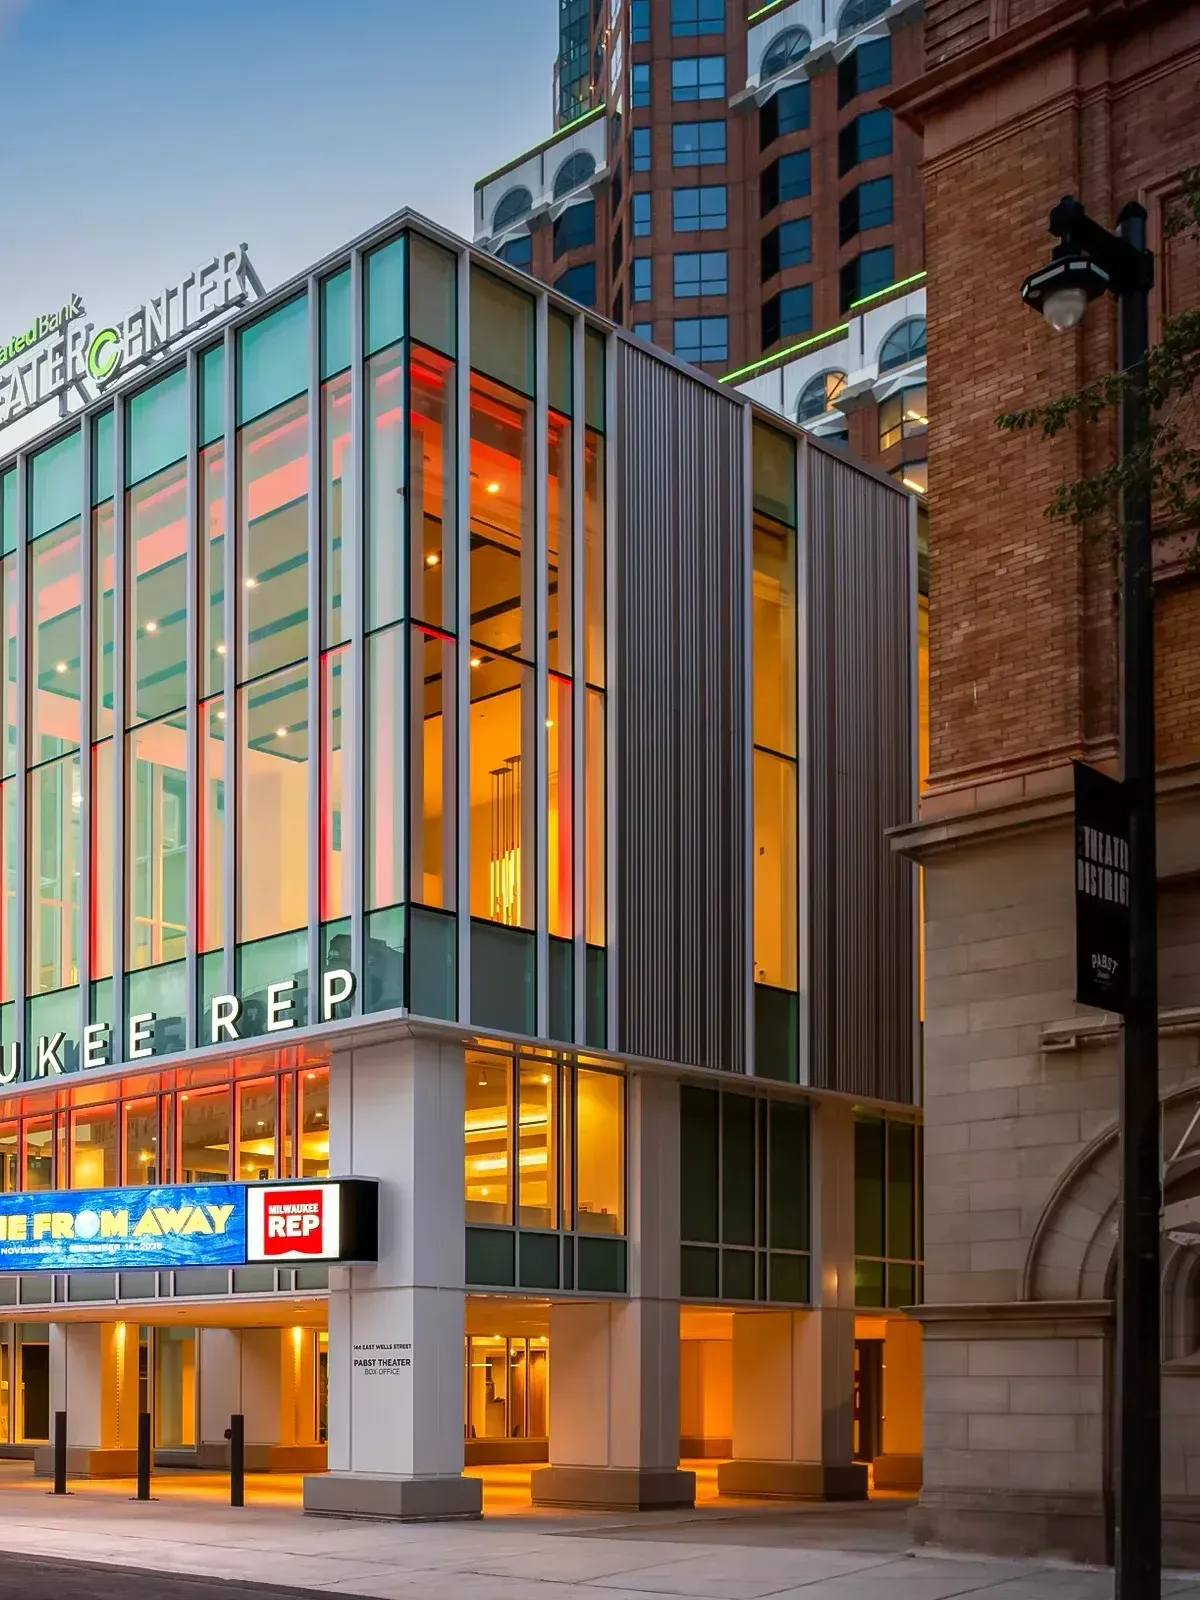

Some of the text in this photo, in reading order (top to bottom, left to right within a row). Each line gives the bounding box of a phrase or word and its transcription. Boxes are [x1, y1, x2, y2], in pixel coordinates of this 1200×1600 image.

[39, 293, 85, 338] Bank
[87, 242, 250, 382] CENTER
[1092, 953, 1118, 974] PABST
[210, 968, 356, 1043] REP
[32, 1209, 129, 1240] FROM
[133, 1204, 235, 1237] AWAY
[268, 1203, 319, 1214] MILWAUKEE
[268, 1214, 320, 1238] REP
[354, 1358, 411, 1367] PABST THEATER
